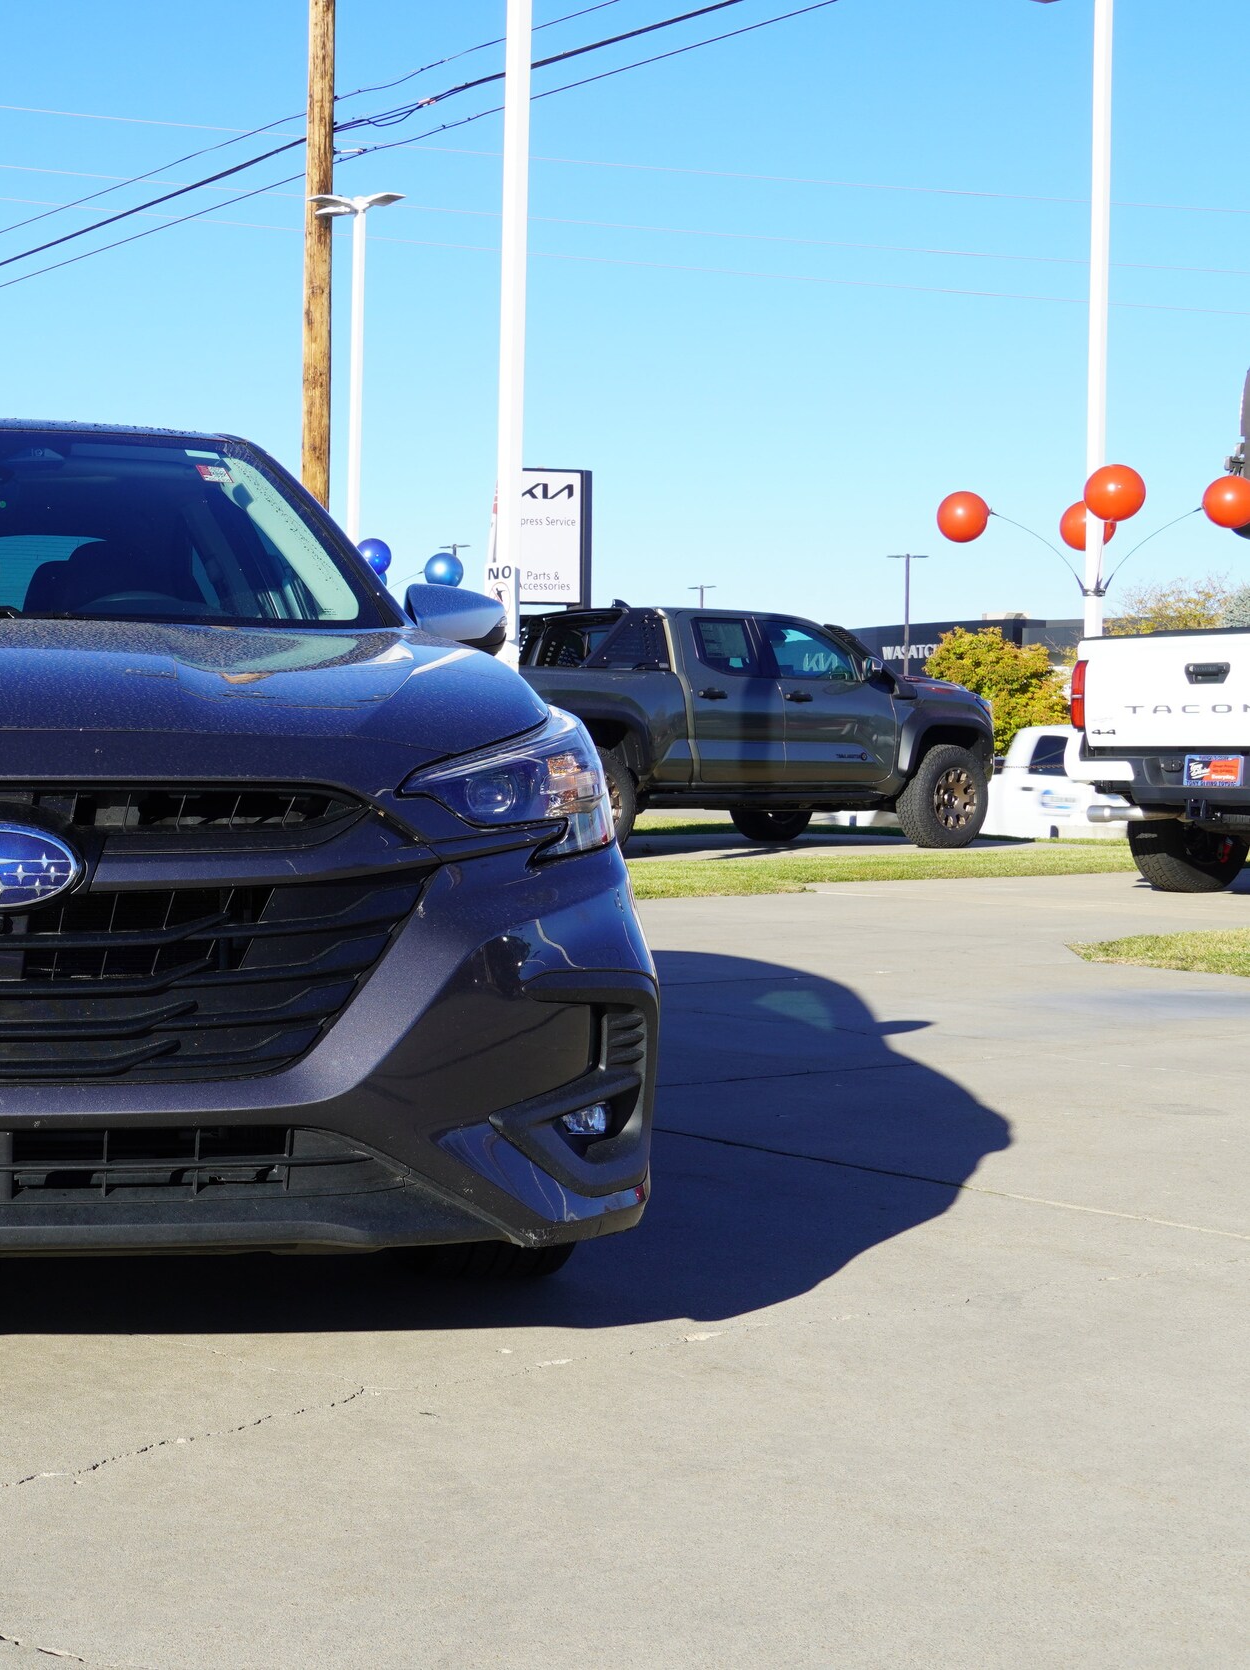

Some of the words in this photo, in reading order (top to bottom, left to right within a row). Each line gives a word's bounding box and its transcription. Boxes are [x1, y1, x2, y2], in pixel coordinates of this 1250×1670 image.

[520, 517, 543, 527] press
[545, 516, 576, 526] Service
[488, 565, 512, 580] NO
[526, 571, 550, 580] Parts
[554, 572, 560, 580] &
[882, 644, 939, 660] WASATC
